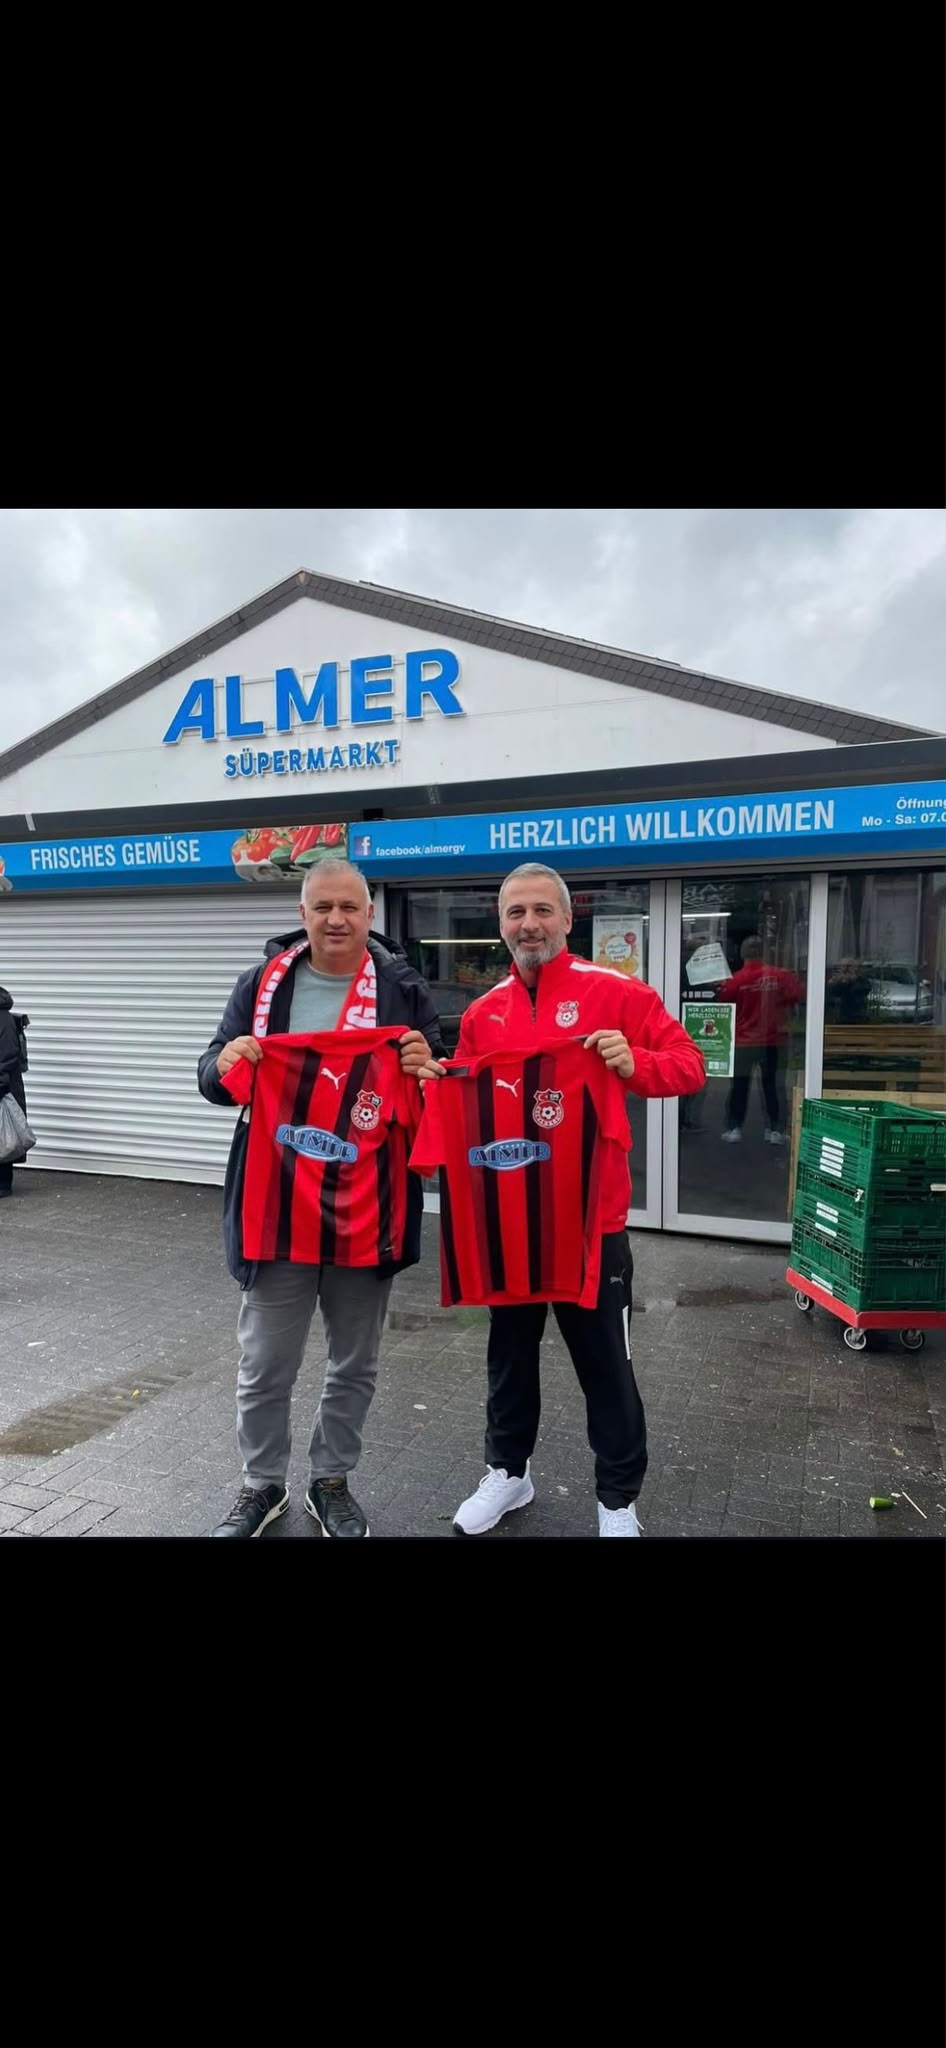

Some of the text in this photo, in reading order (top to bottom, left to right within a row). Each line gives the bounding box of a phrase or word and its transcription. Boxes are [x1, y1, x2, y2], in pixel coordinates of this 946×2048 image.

[162, 648, 467, 744] ALMER
[224, 739, 399, 779] SÜPERMARKT
[490, 799, 835, 850] HERZLICH WILLKOMMEN
[861, 816, 883, 827] Mo
[894, 813, 917, 825] Sa:
[30, 835, 201, 871] FRISCHES GEMÜSE
[375, 843, 466, 857] facebook/almergv
